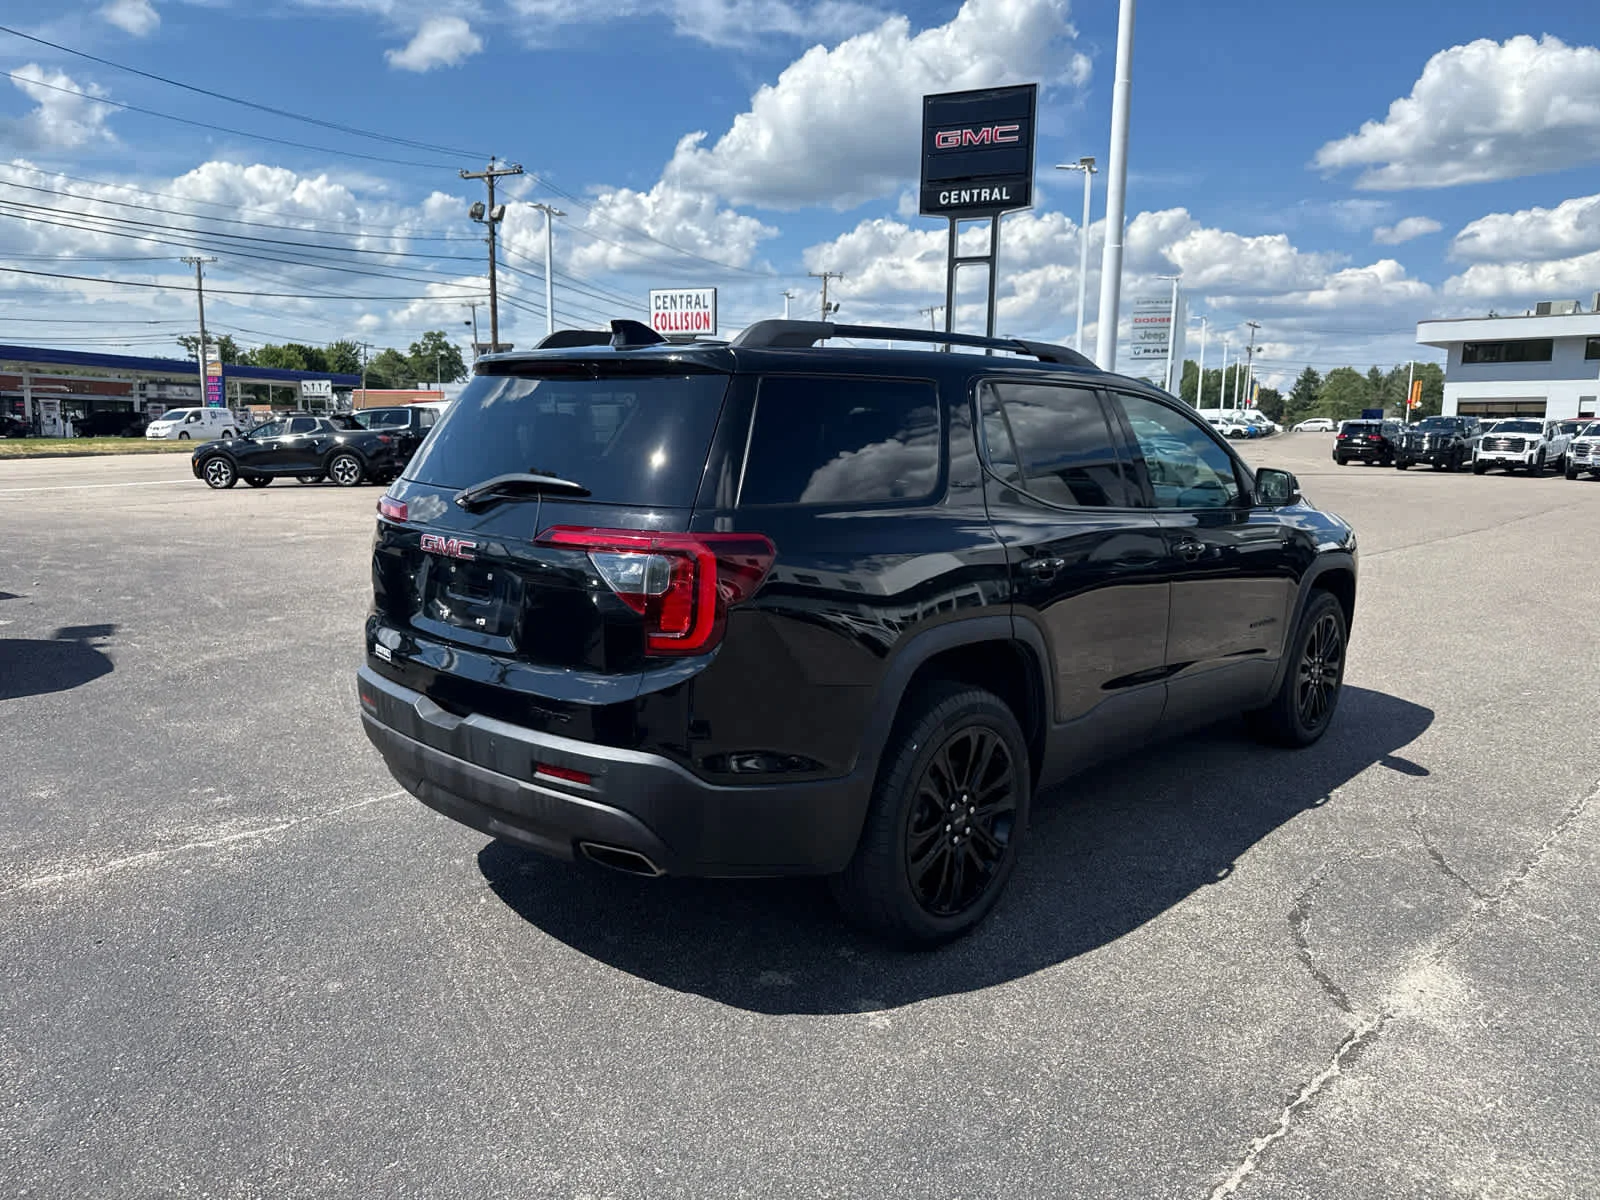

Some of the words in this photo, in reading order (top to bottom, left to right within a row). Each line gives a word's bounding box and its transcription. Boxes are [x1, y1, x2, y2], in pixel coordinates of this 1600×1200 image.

[935, 124, 1019, 149] GMC
[939, 186, 1011, 206] CENTRAL
[654, 293, 709, 310] CENTRAL
[653, 311, 711, 331] COLLISION
[1139, 330, 1167, 341] Jeep
[420, 533, 477, 561] GMC
